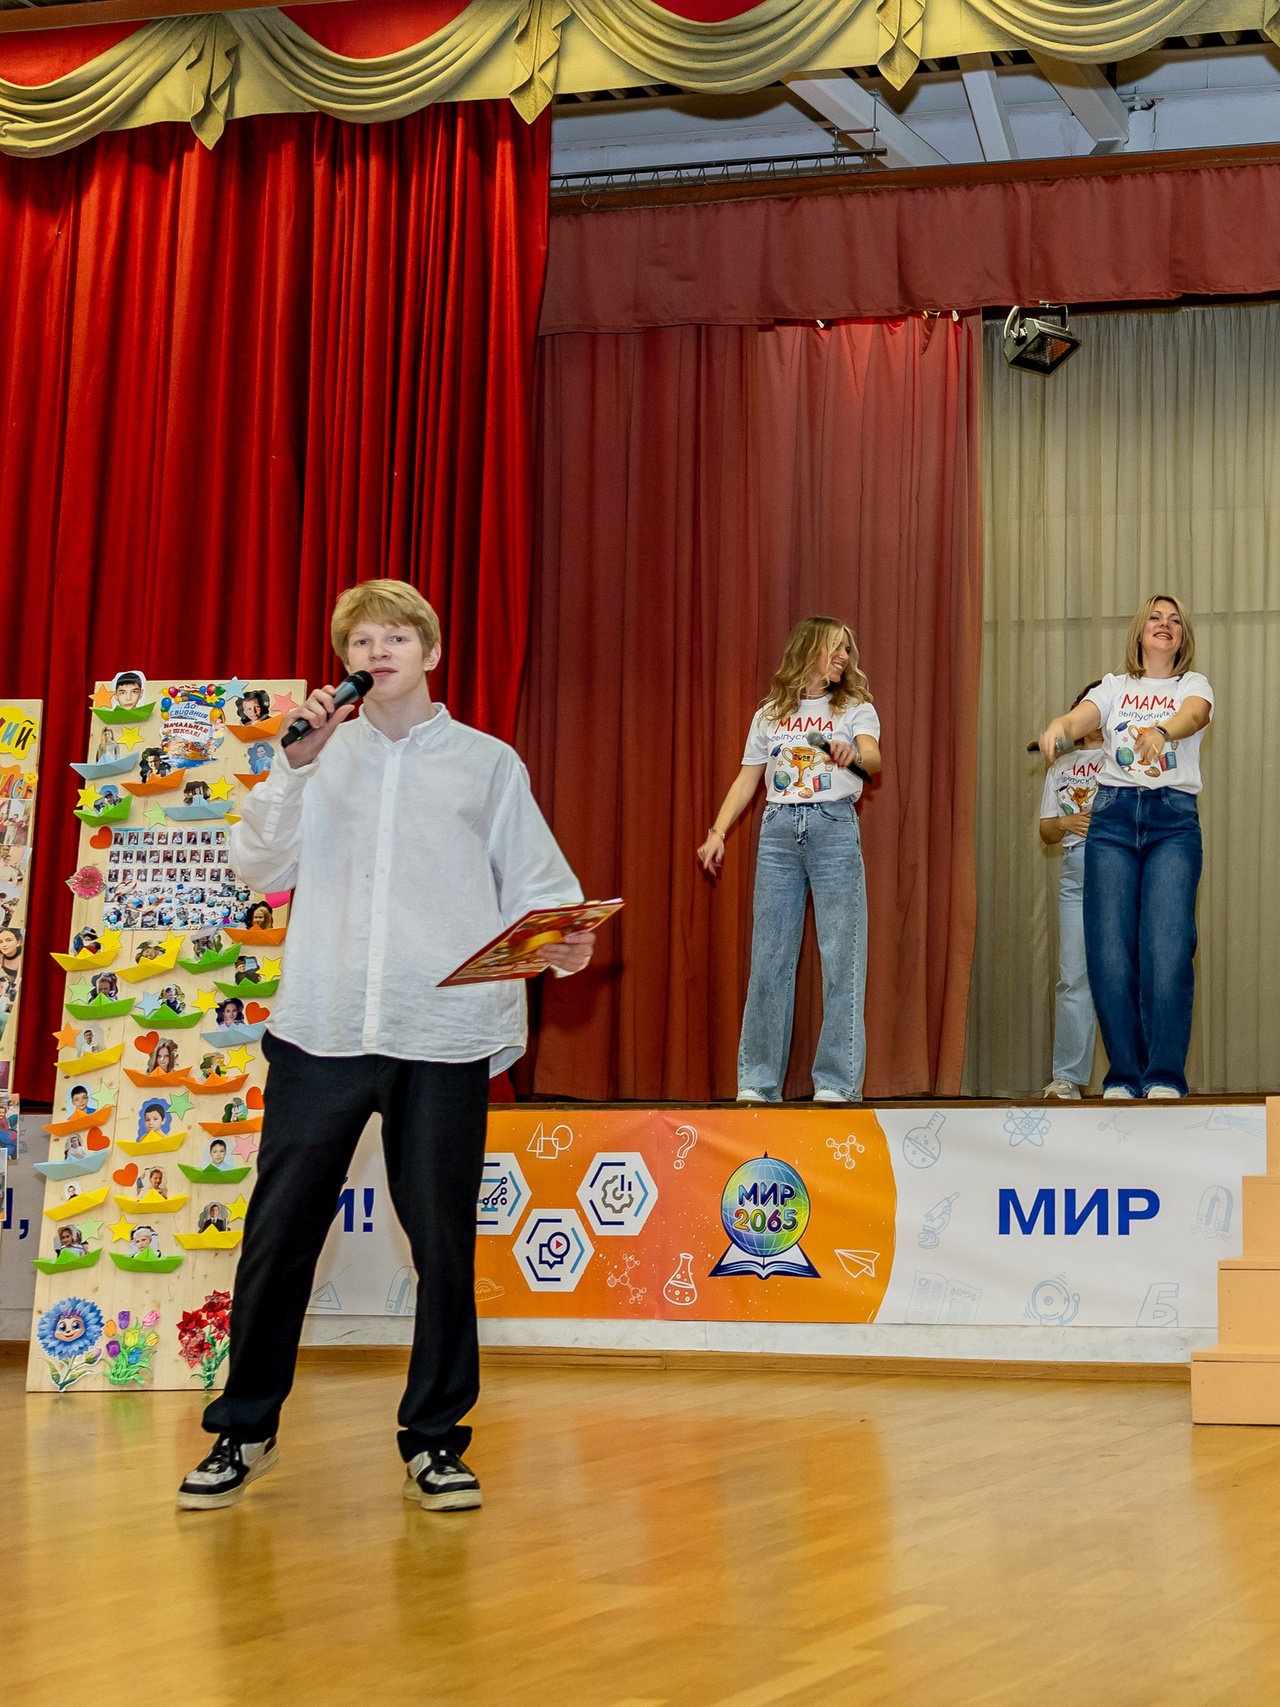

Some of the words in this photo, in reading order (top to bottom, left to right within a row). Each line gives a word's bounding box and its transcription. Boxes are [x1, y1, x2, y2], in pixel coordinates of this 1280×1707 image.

[1121, 693, 1176, 711] МАМА
[774, 716, 834, 735] МАМА
[738, 1181, 797, 1207] МИР
[733, 1208, 799, 1234] 2065
[998, 1188, 1161, 1236] МИР
